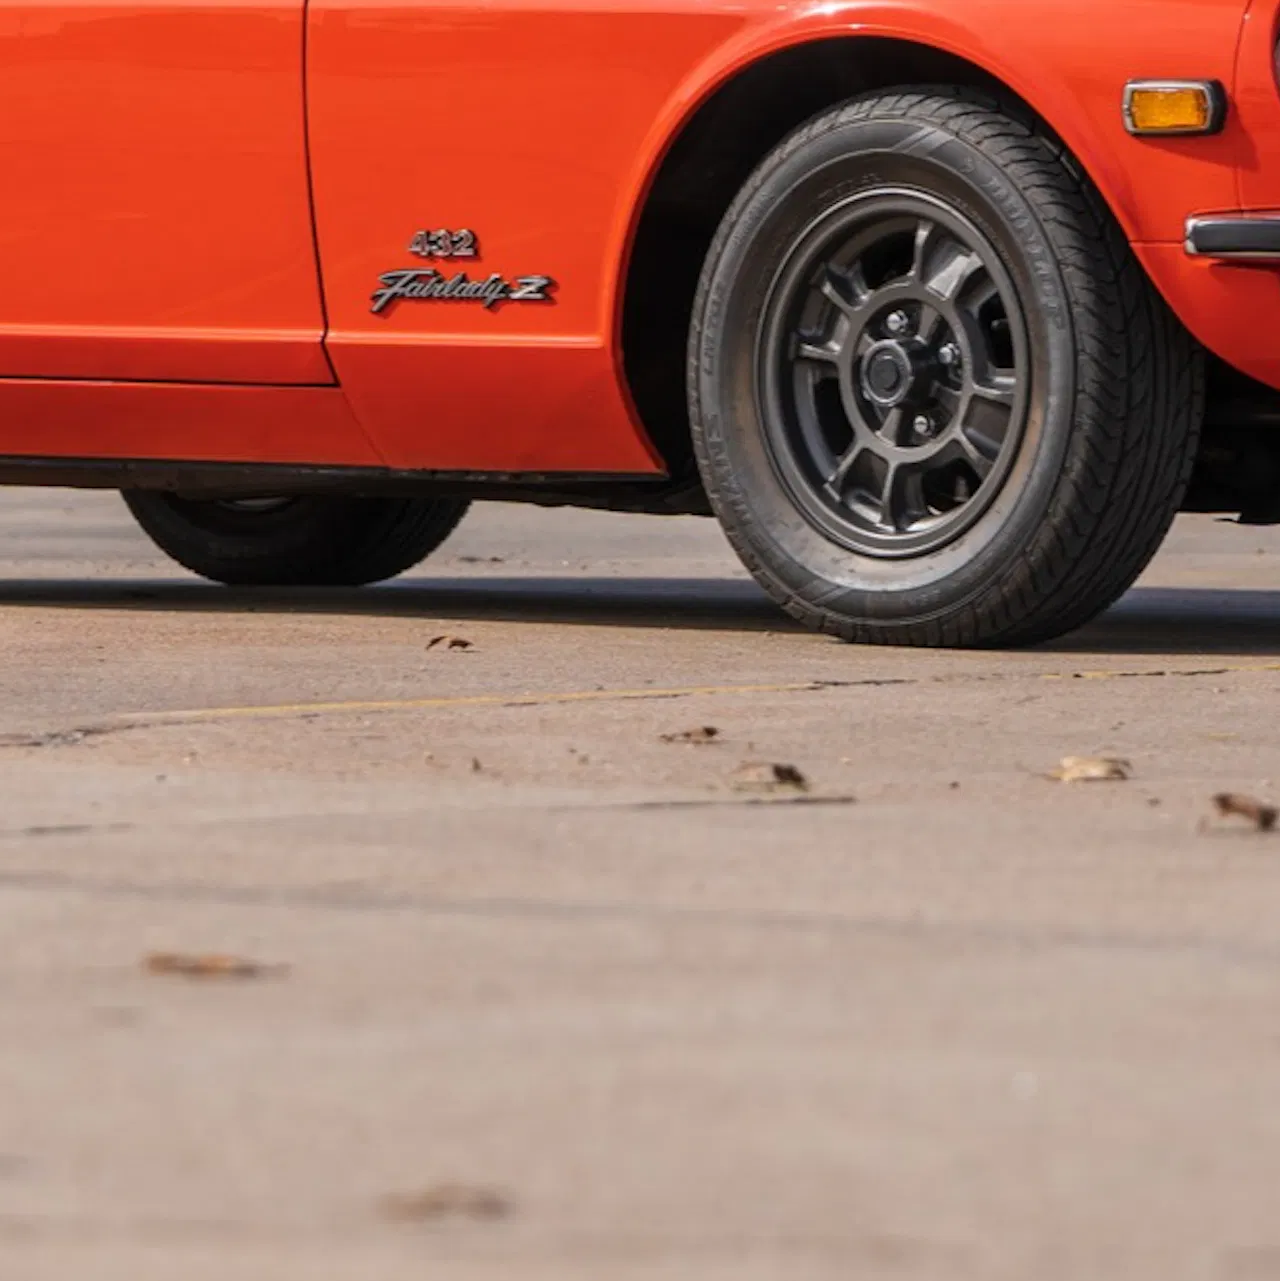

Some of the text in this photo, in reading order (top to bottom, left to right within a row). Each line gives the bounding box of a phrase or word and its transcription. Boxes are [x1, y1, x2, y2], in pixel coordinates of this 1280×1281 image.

[408, 227, 478, 258] 432
[370, 266, 552, 313] Fairlady Z
